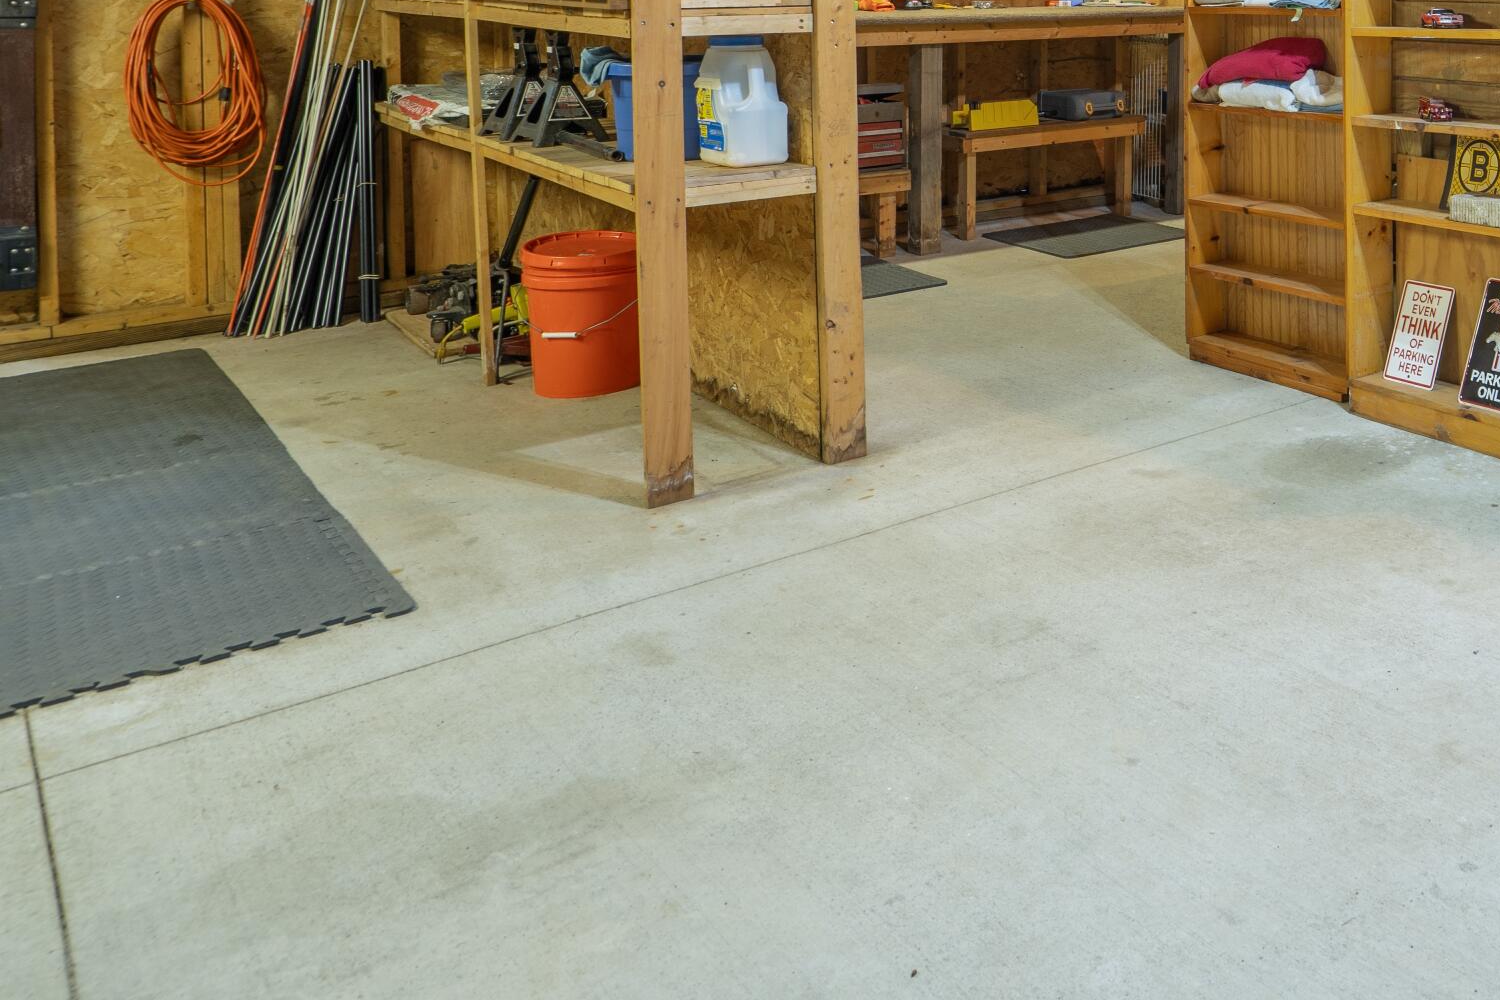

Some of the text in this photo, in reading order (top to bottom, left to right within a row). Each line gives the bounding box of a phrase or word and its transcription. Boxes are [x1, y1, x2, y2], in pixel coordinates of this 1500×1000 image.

[1469, 149, 1489, 182] B
[1412, 291, 1442, 306] DON'T
[1412, 304, 1437, 318] EVEN
[1401, 315, 1442, 340] THINK
[1409, 338, 1424, 349] OF
[1393, 347, 1434, 366] PARKING
[1398, 361, 1424, 377] HERE
